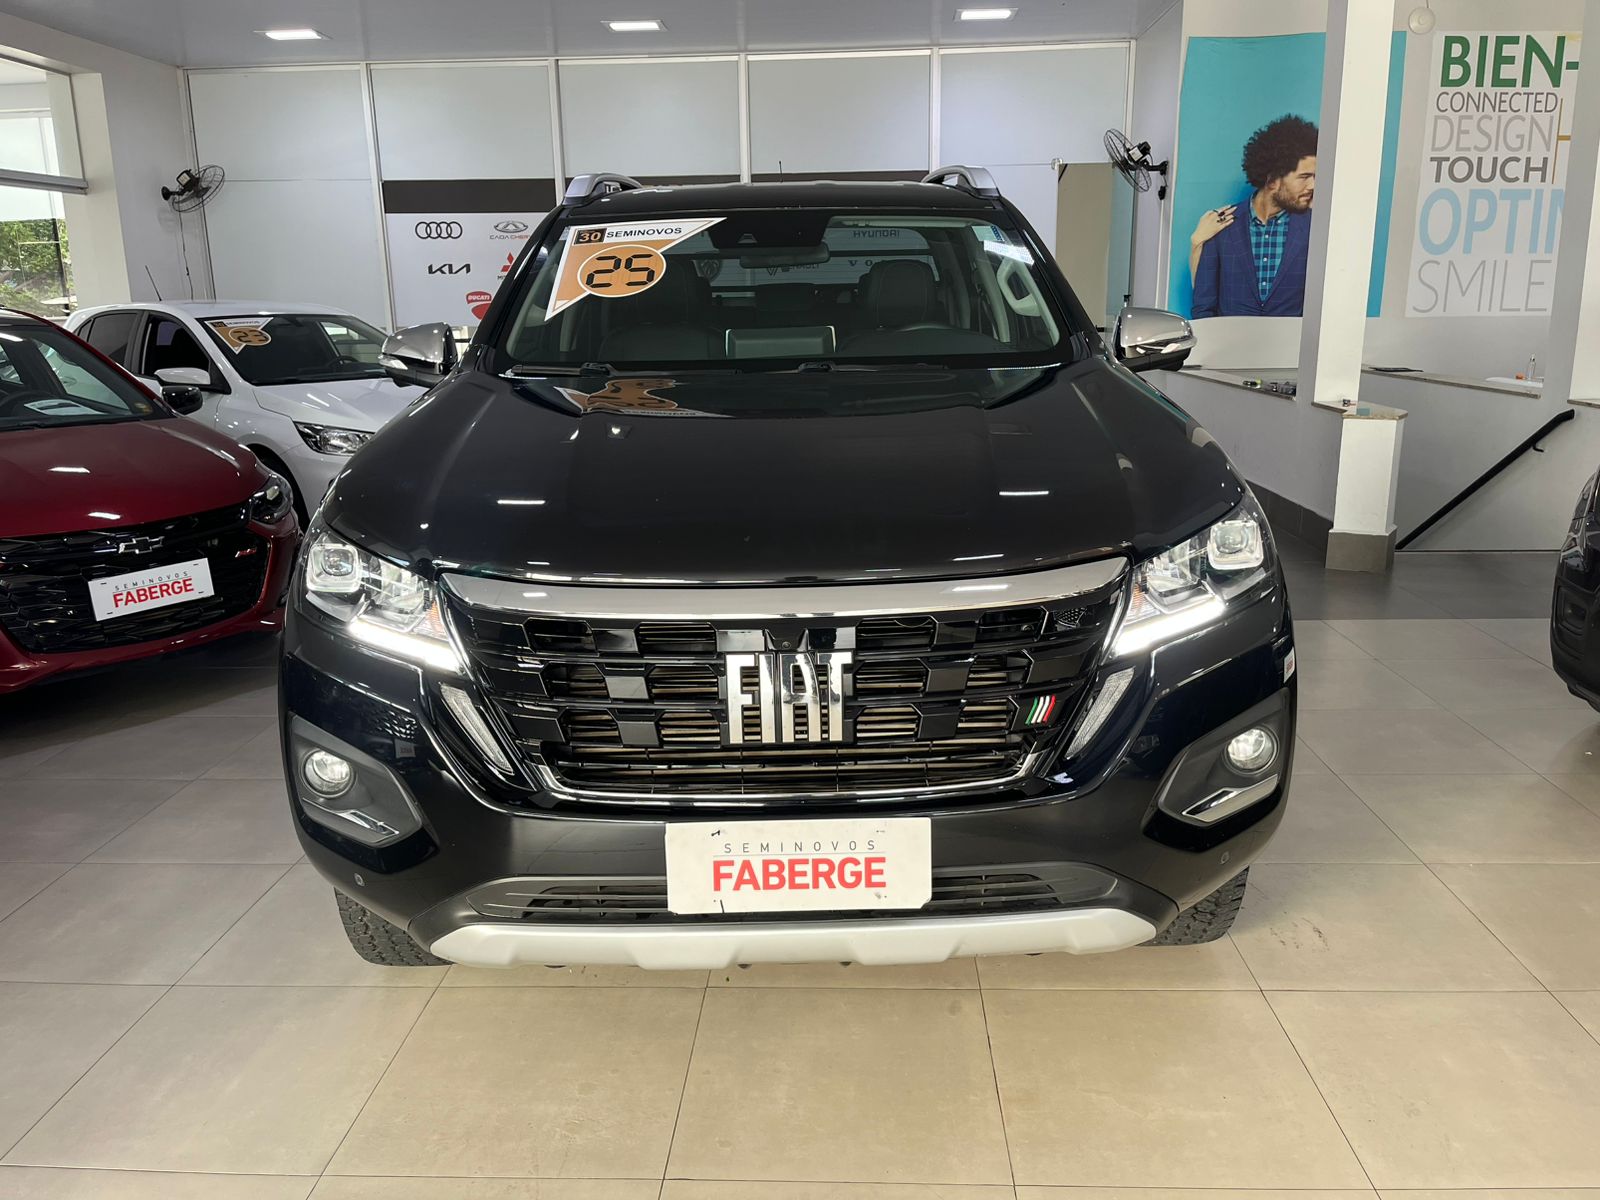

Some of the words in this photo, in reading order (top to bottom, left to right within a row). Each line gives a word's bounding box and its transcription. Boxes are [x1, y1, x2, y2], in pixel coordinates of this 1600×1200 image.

[1440, 35, 1579, 88] BIEN-
[1435, 91, 1558, 113] CONNECTED
[1431, 114, 1554, 153] DESIGN
[1429, 156, 1548, 183] TOUCH
[578, 232, 601, 242] 30
[606, 227, 682, 238] SEMINOVOS
[853, 229, 900, 238] HYUNDAI
[427, 263, 471, 275] KIA
[585, 253, 655, 289] 25
[1412, 259, 1552, 314] SMILE
[232, 329, 269, 343] 23
[112, 578, 194, 608] FABERGE
[115, 571, 188, 591] SEMINOVOS
[726, 651, 852, 744] FIAT
[724, 840, 875, 854] SEMINOVOS
[712, 857, 886, 892] FABERGE
